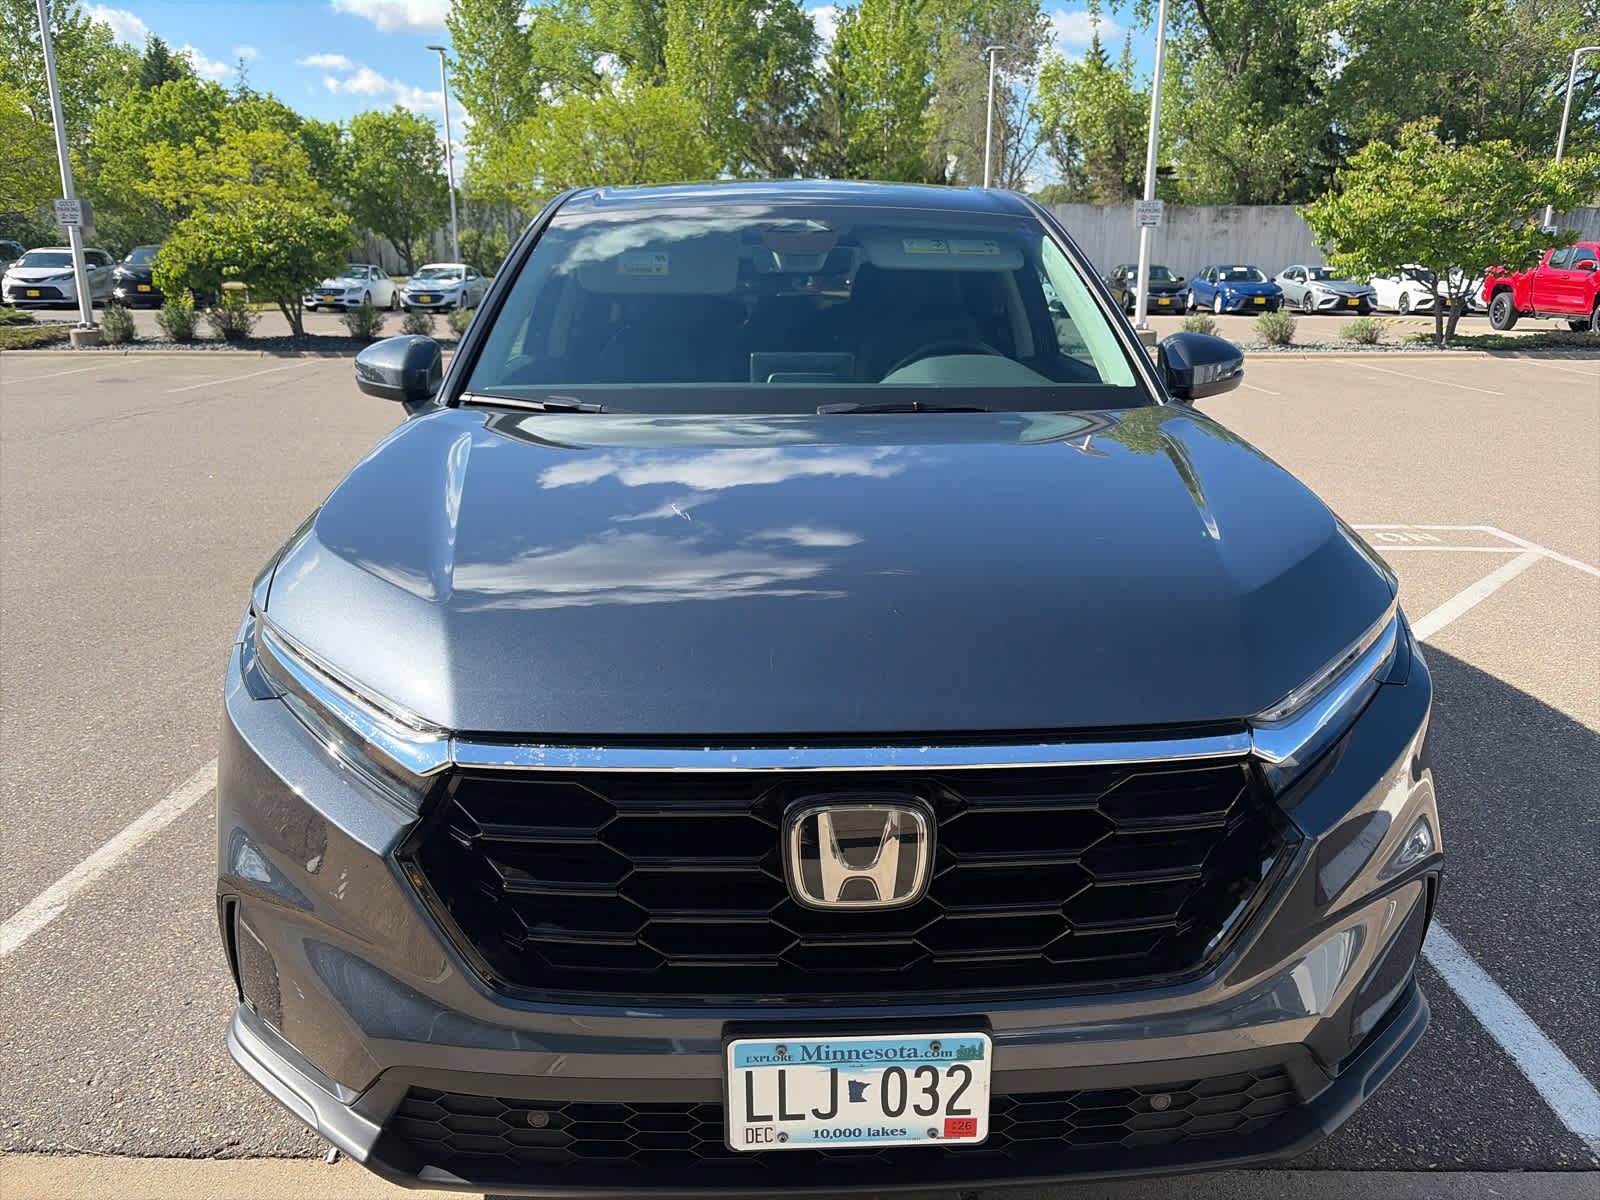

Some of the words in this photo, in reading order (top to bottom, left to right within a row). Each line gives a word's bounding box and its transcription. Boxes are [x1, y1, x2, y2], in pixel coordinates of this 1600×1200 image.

[746, 1055, 793, 1064] EXPLORE
[745, 1067, 839, 1123] LLJ
[880, 1064, 972, 1119] 032
[745, 1127, 774, 1144] DEC
[814, 1127, 862, 1140] 10,000
[867, 1126, 907, 1138] lakes
